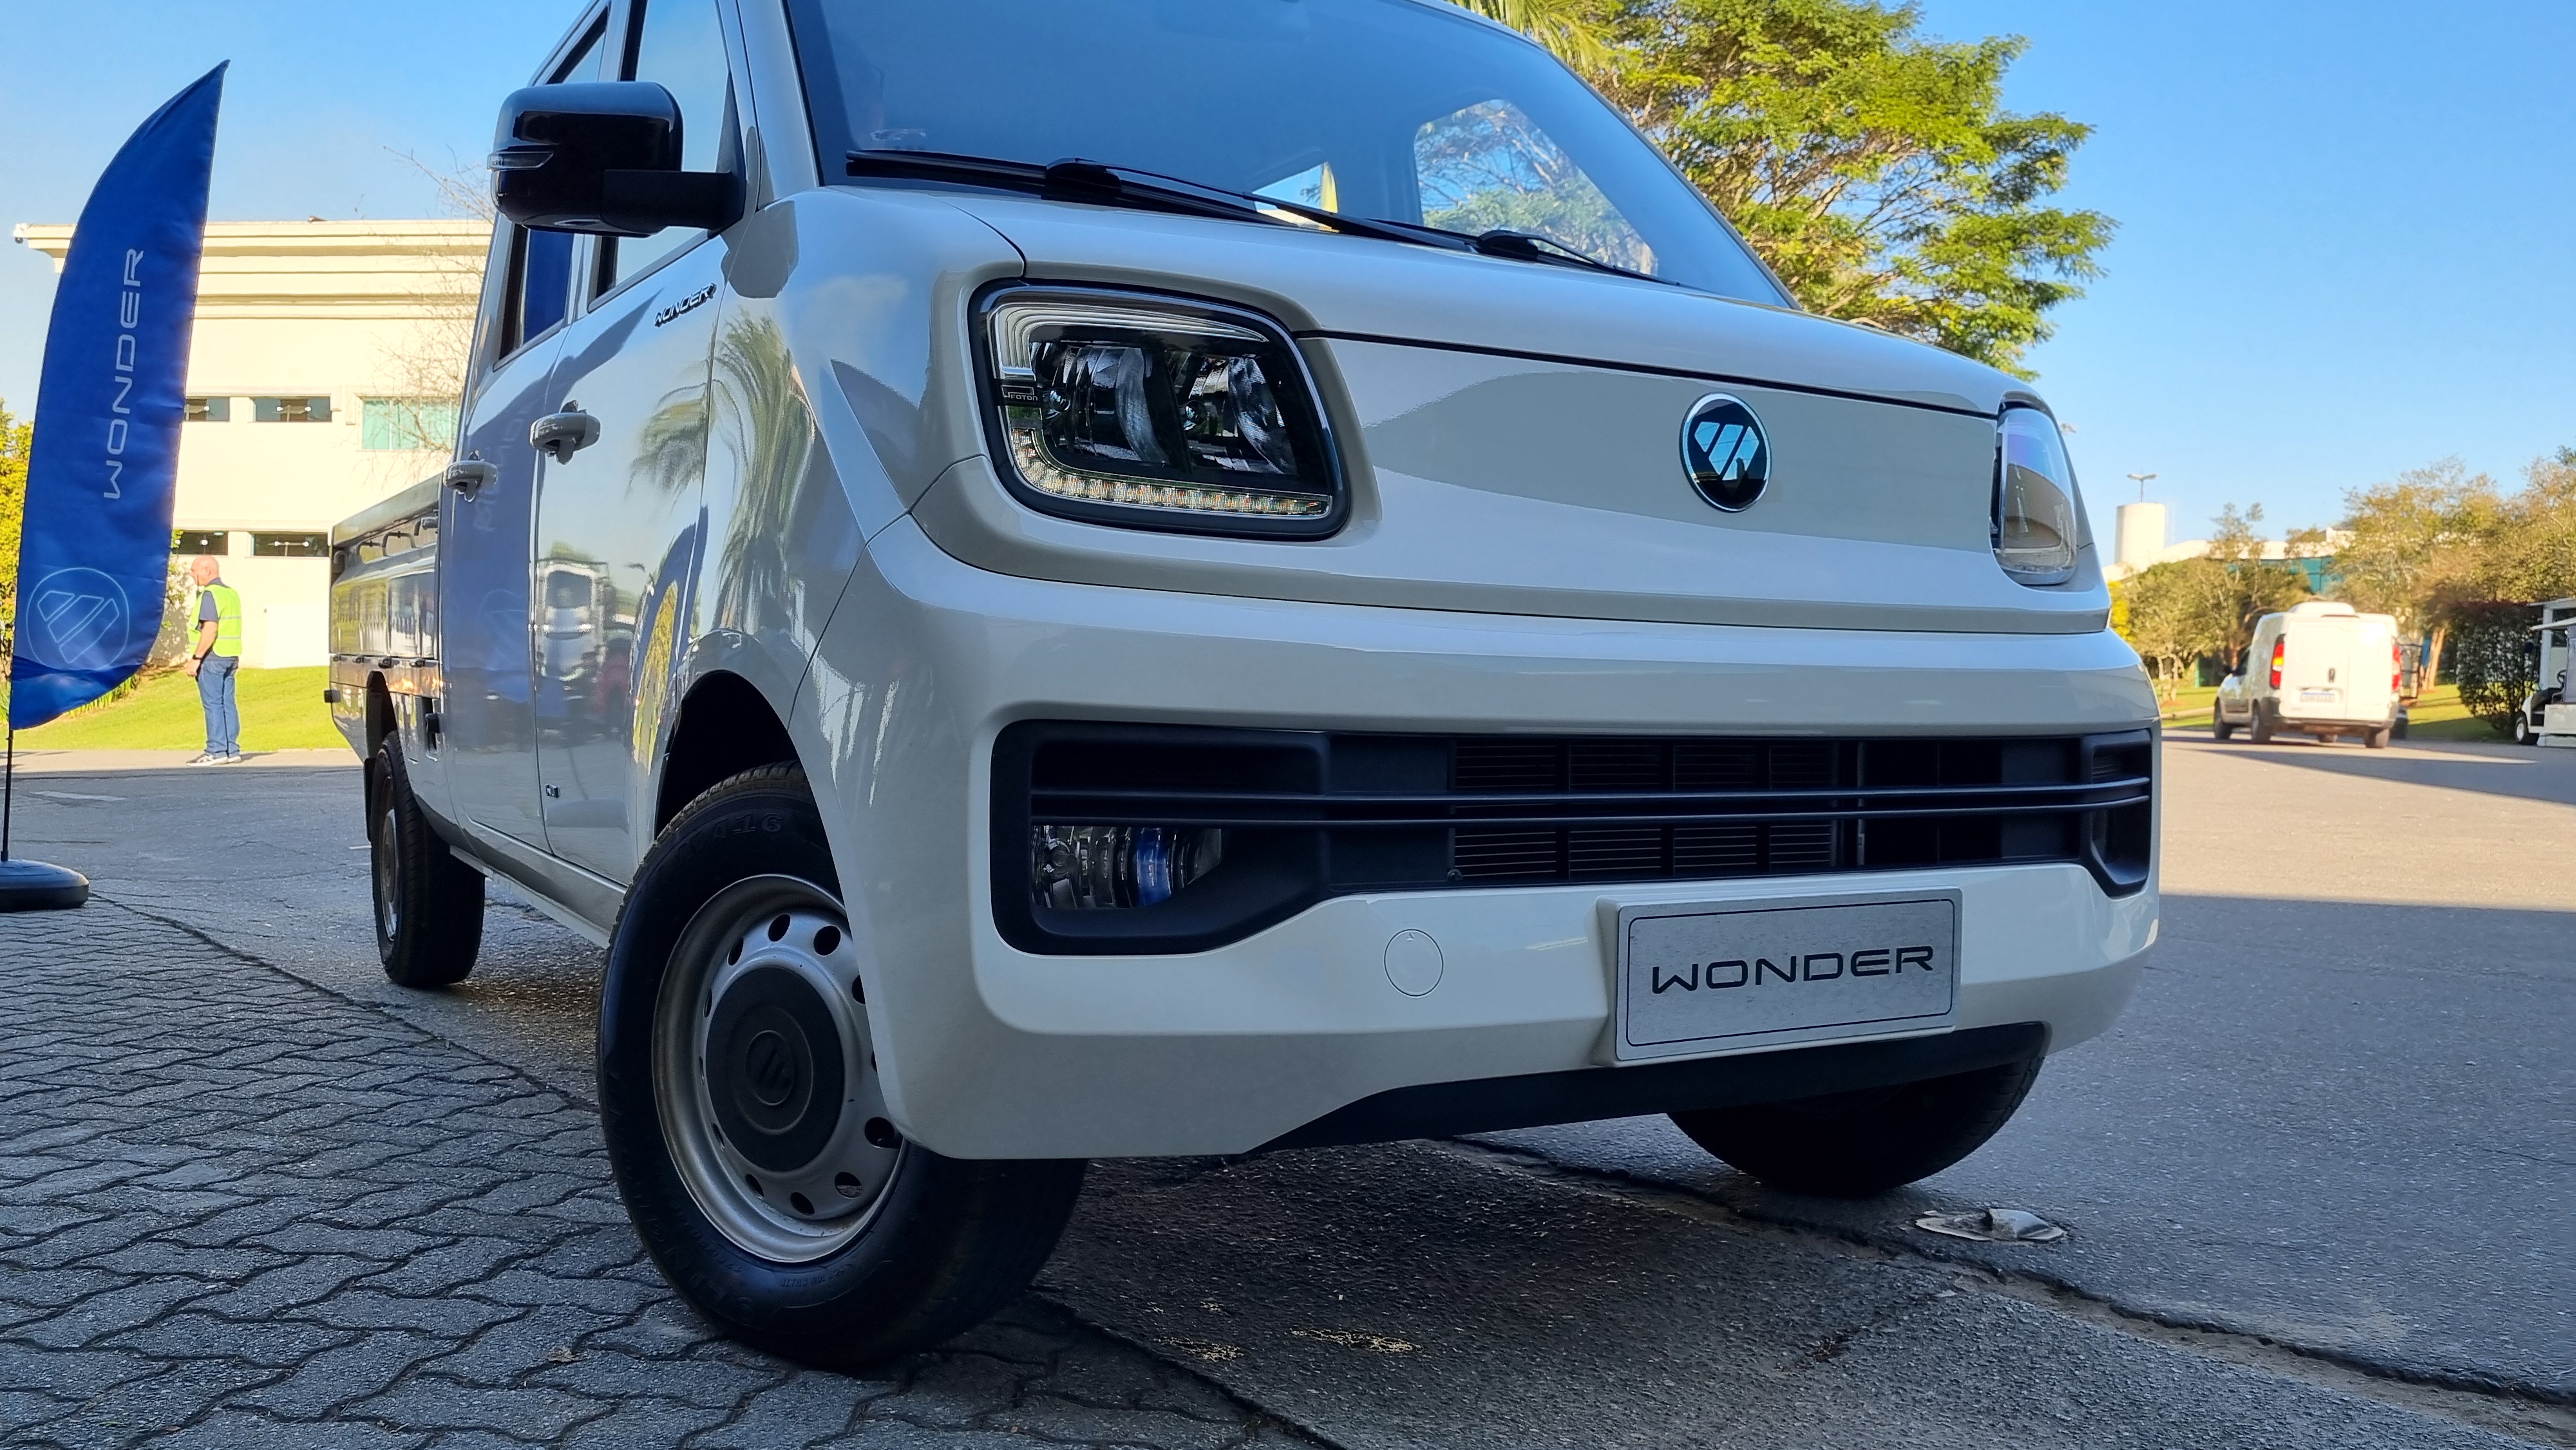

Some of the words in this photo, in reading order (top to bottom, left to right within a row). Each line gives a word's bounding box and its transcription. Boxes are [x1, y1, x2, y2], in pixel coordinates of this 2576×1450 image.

[654, 283, 717, 327] WONDER
[103, 248, 144, 499] WONDER
[1652, 945, 1934, 994] WONDER
